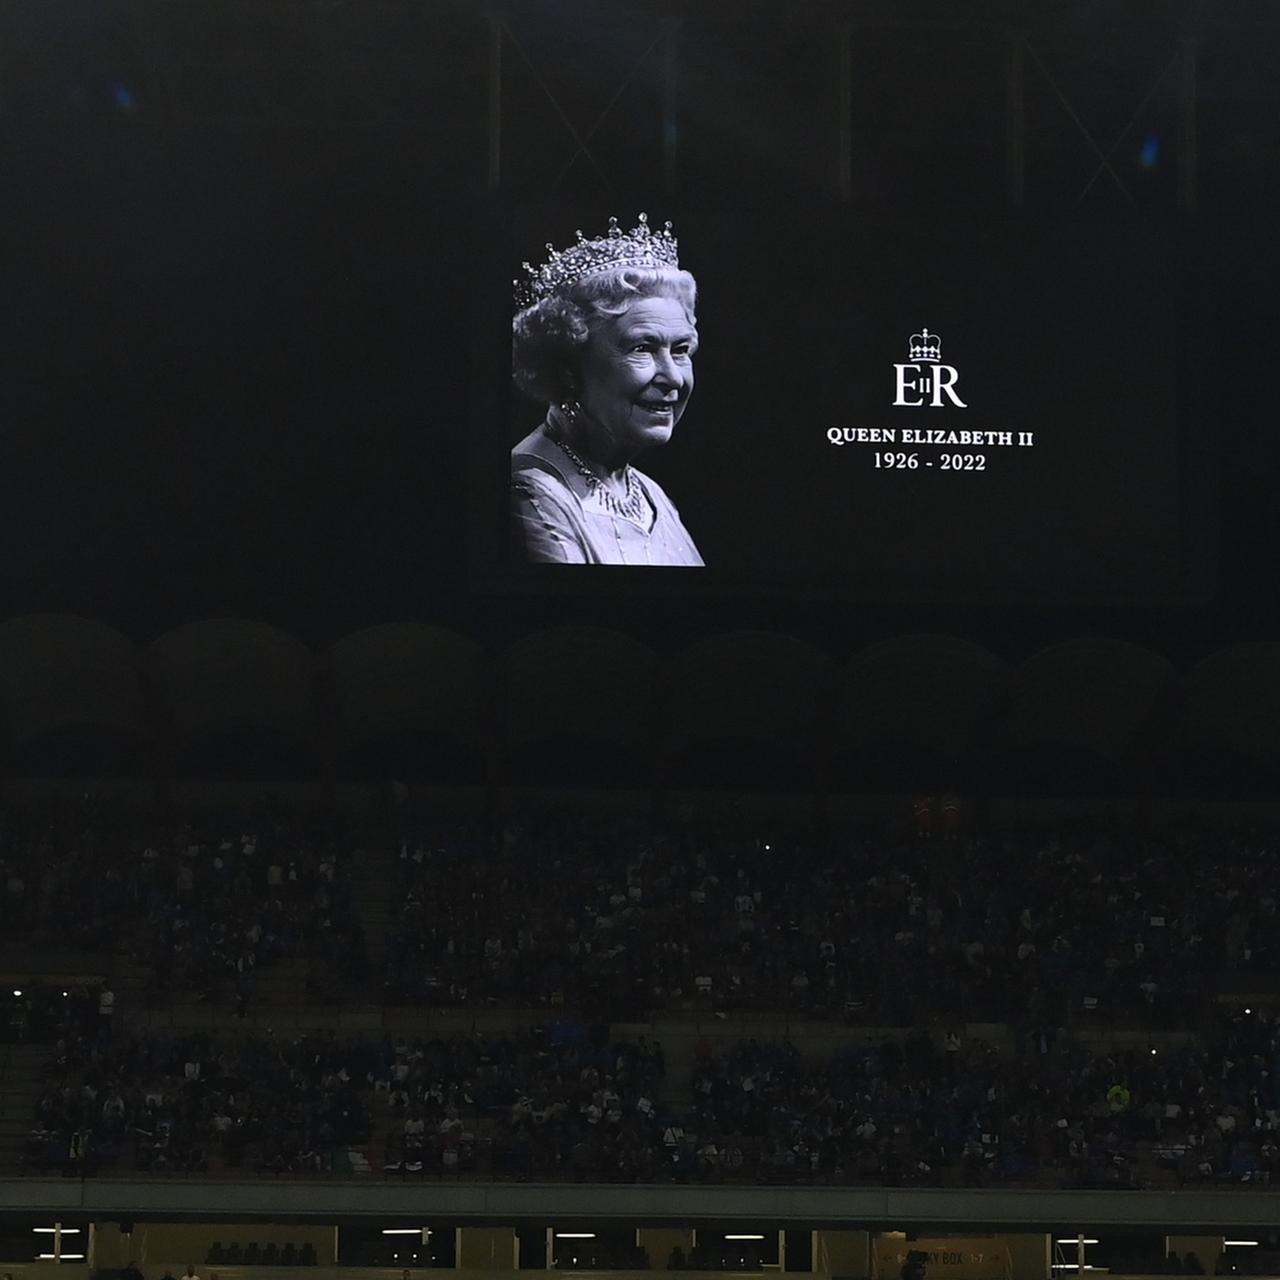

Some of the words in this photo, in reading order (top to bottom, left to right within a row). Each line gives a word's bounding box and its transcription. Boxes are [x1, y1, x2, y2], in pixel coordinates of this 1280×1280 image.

[827, 427, 896, 445] QUEEN
[901, 429, 1013, 446] ELIZABETH
[1018, 431, 1034, 446] II
[874, 452, 919, 469] 1926
[940, 453, 986, 471] 2022
[942, 1252, 963, 1264] BOX
